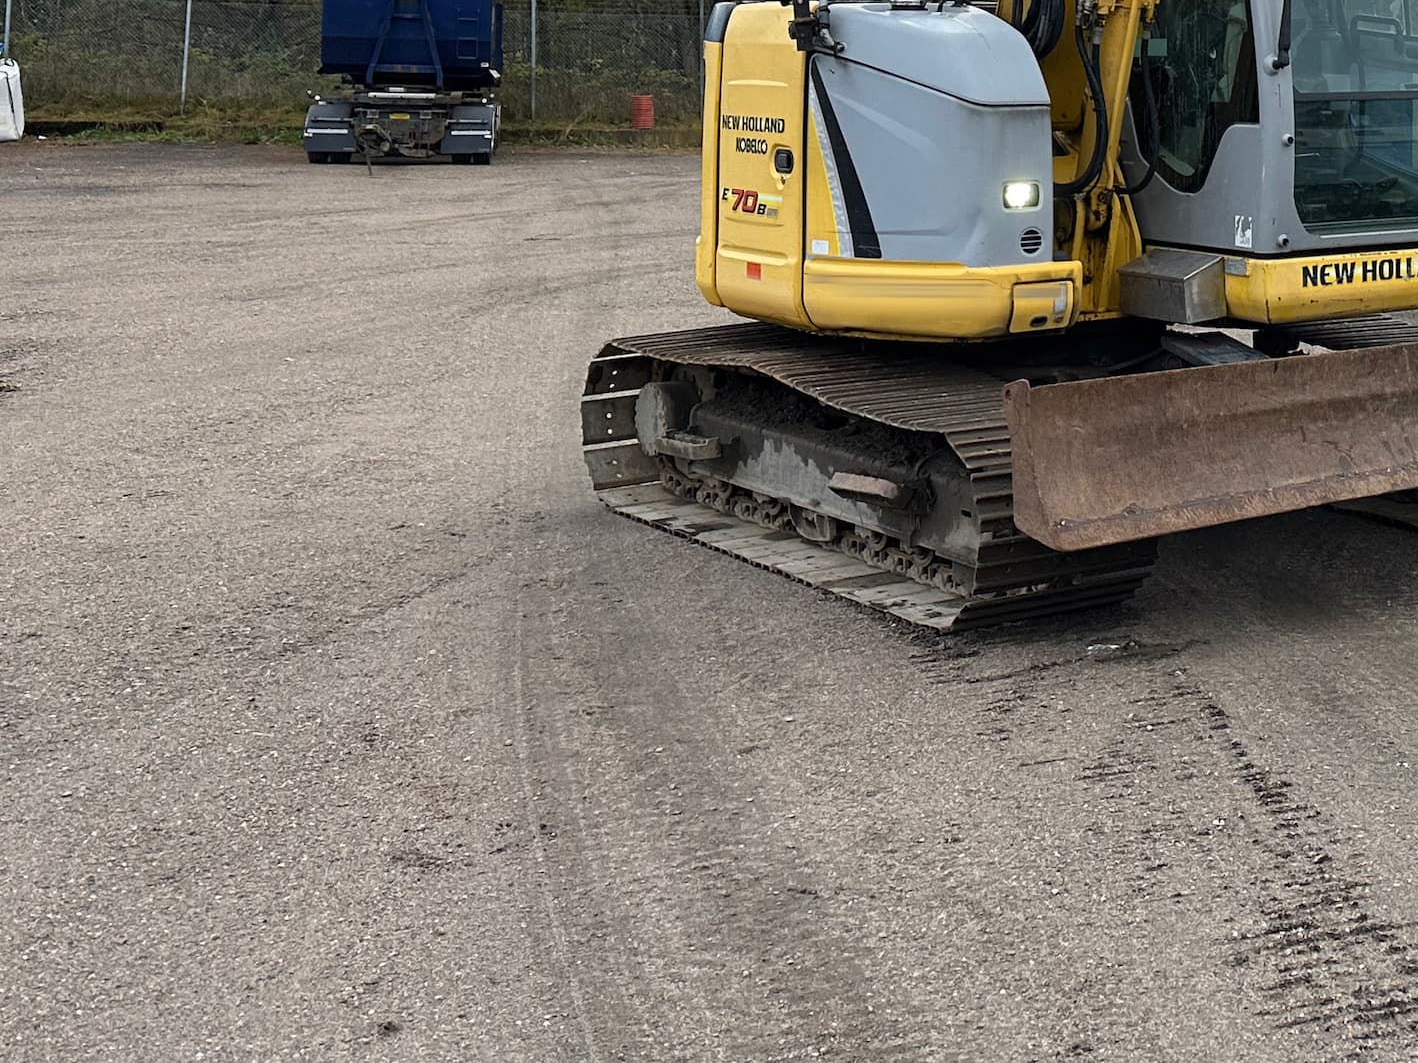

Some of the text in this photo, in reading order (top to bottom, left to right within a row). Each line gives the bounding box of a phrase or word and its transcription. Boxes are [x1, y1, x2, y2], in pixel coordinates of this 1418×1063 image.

[722, 114, 785, 134] NEW HOLLAND
[735, 137, 768, 154] KOBELCO
[1302, 262, 1356, 287] NEW
